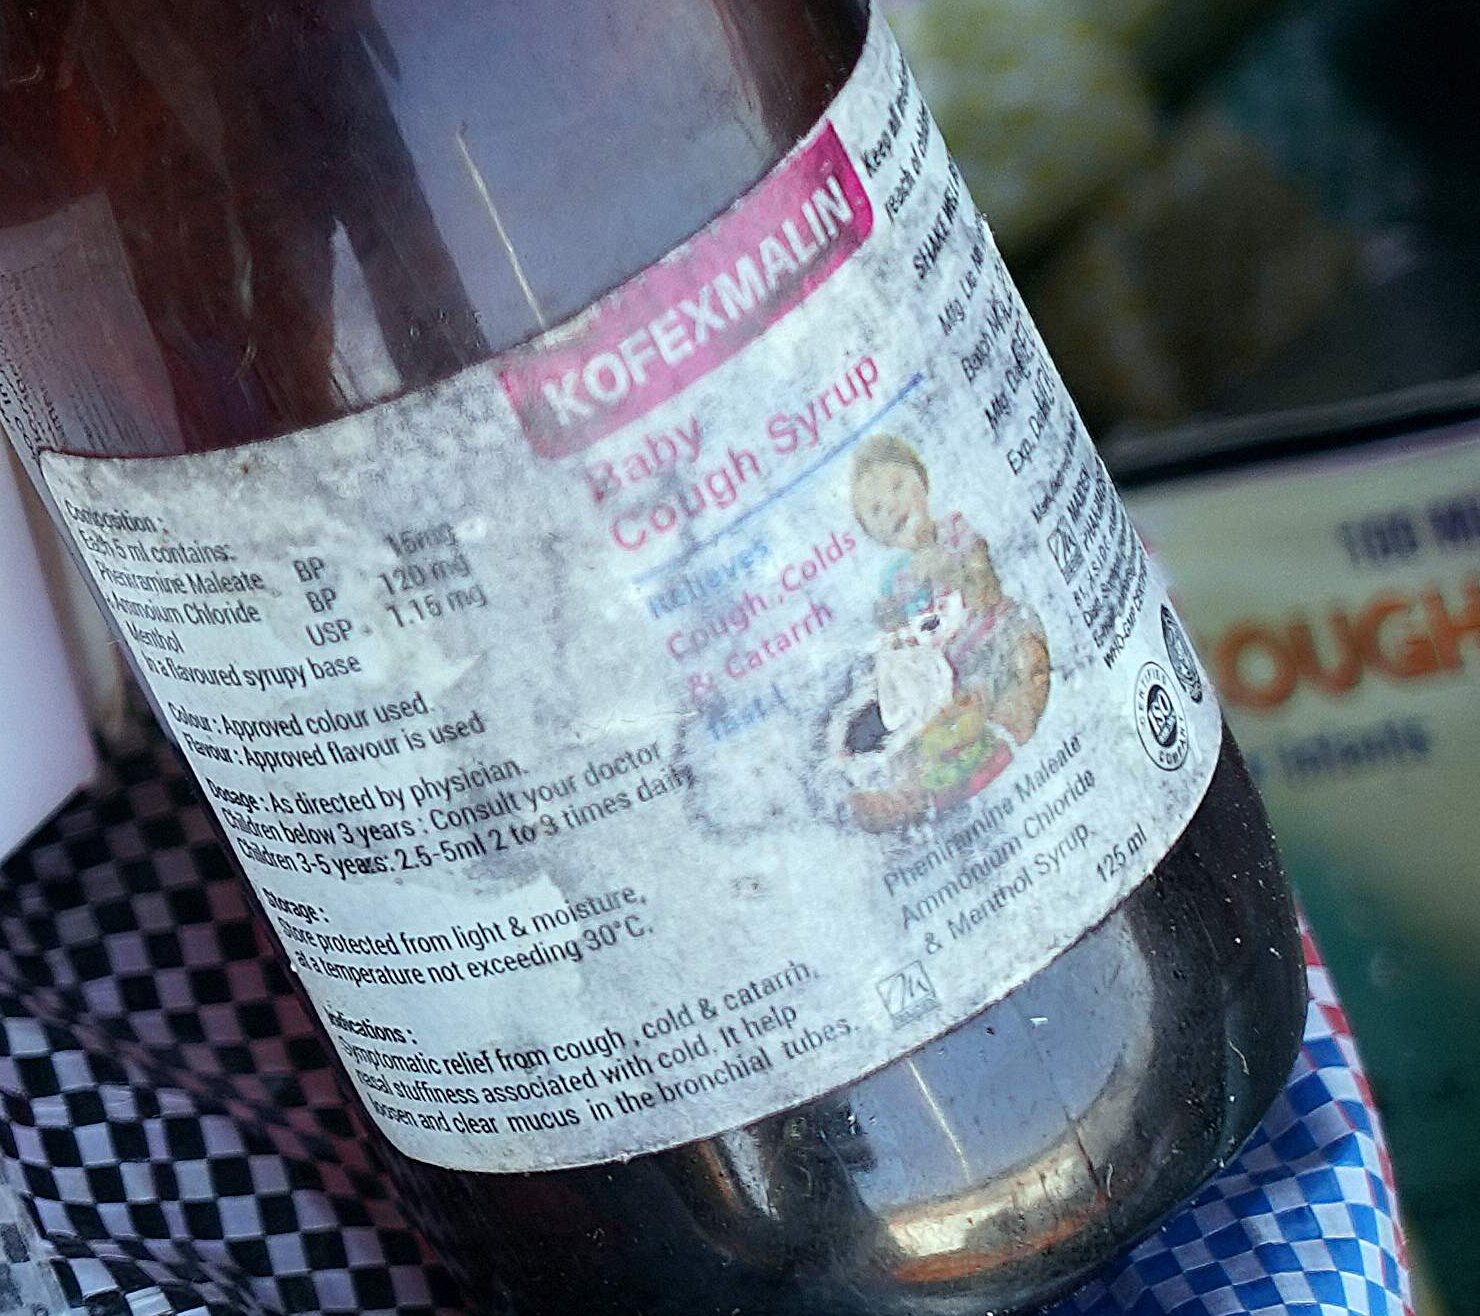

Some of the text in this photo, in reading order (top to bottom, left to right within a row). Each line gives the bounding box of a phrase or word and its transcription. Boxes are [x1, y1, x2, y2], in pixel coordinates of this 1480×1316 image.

[542, 170, 858, 434] KOFEXMALIN
[577, 415, 714, 504] Baby
[603, 355, 879, 562] Cough Syrup
[1122, 824, 1148, 861] ml
